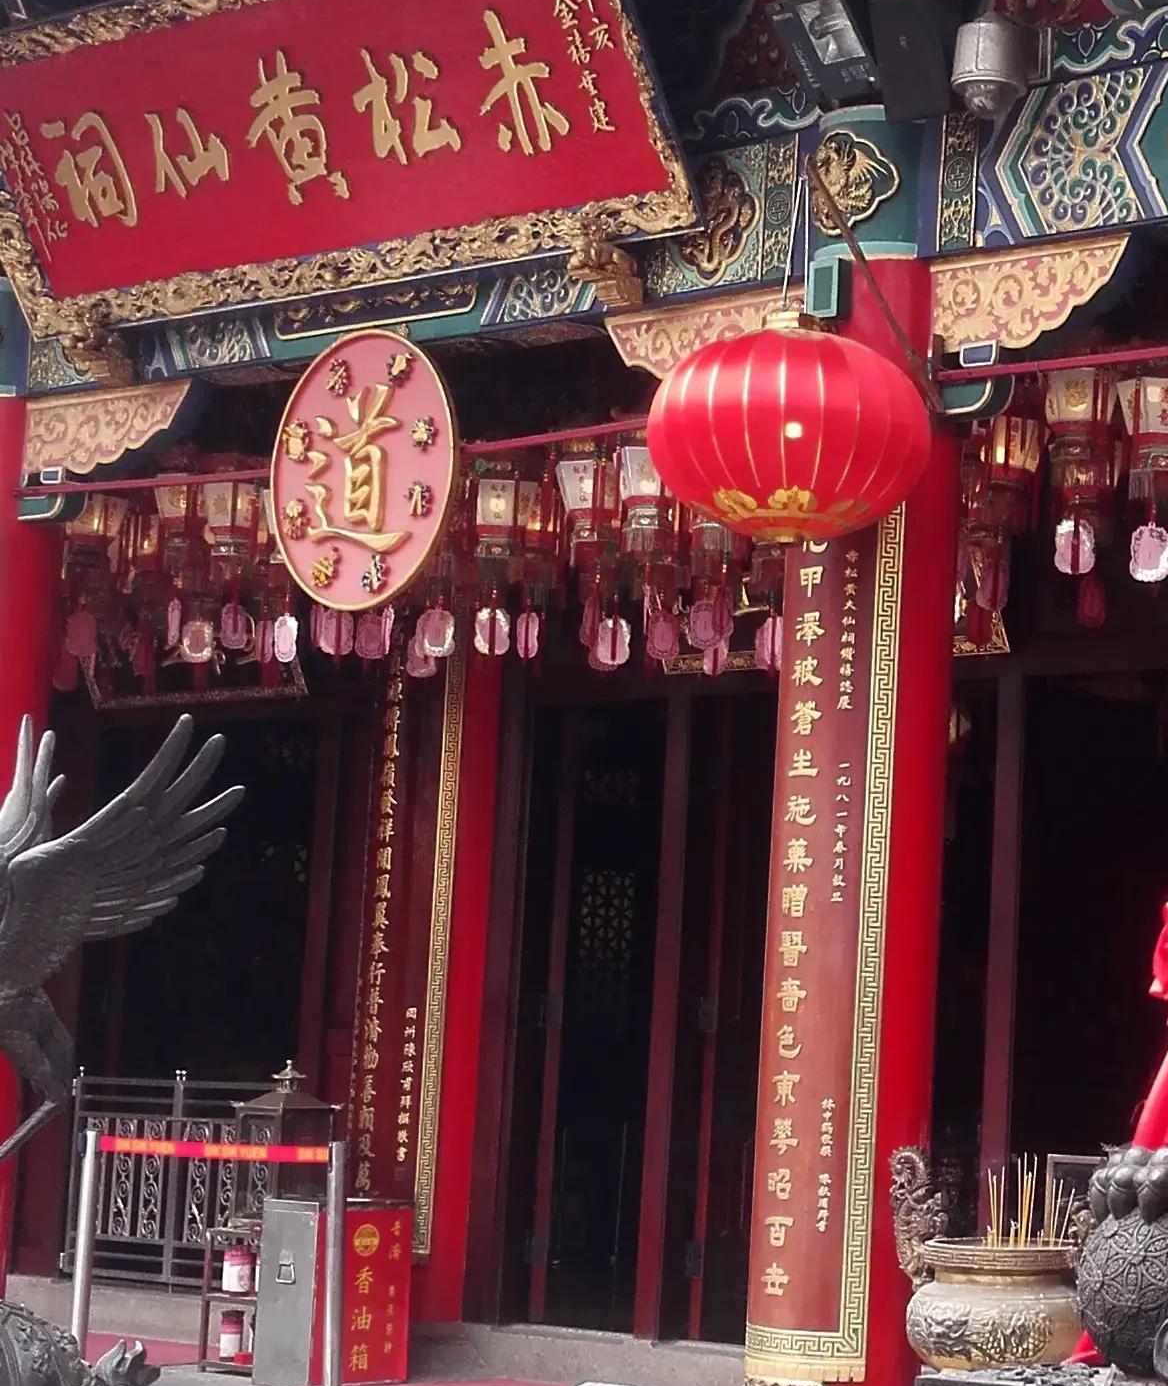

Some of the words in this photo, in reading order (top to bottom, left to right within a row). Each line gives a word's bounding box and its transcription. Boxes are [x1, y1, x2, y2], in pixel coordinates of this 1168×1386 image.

[306, 383, 412, 553] 道
[348, 1266, 375, 1372] 香油箱
